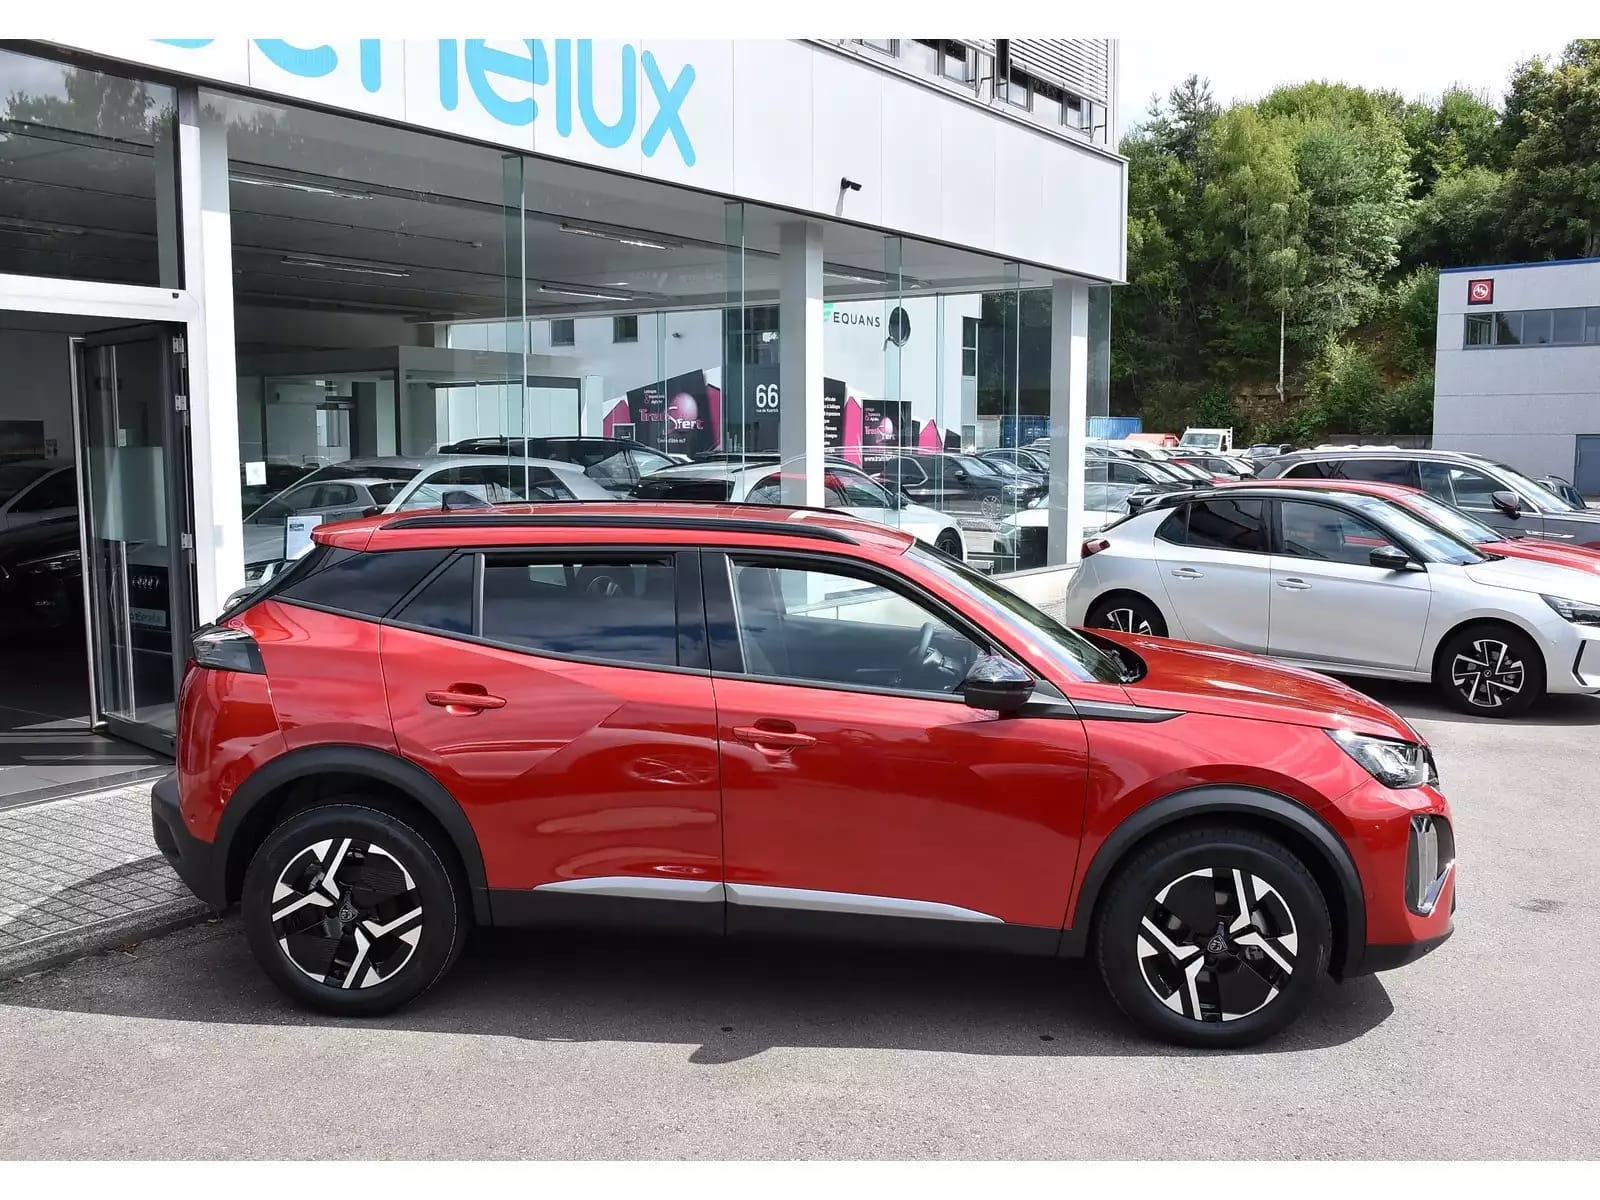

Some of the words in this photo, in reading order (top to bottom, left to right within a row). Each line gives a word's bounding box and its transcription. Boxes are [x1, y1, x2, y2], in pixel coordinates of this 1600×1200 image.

[147, 38, 696, 168] elux
[833, 311, 881, 328] EQUANS
[756, 383, 779, 408] 66
